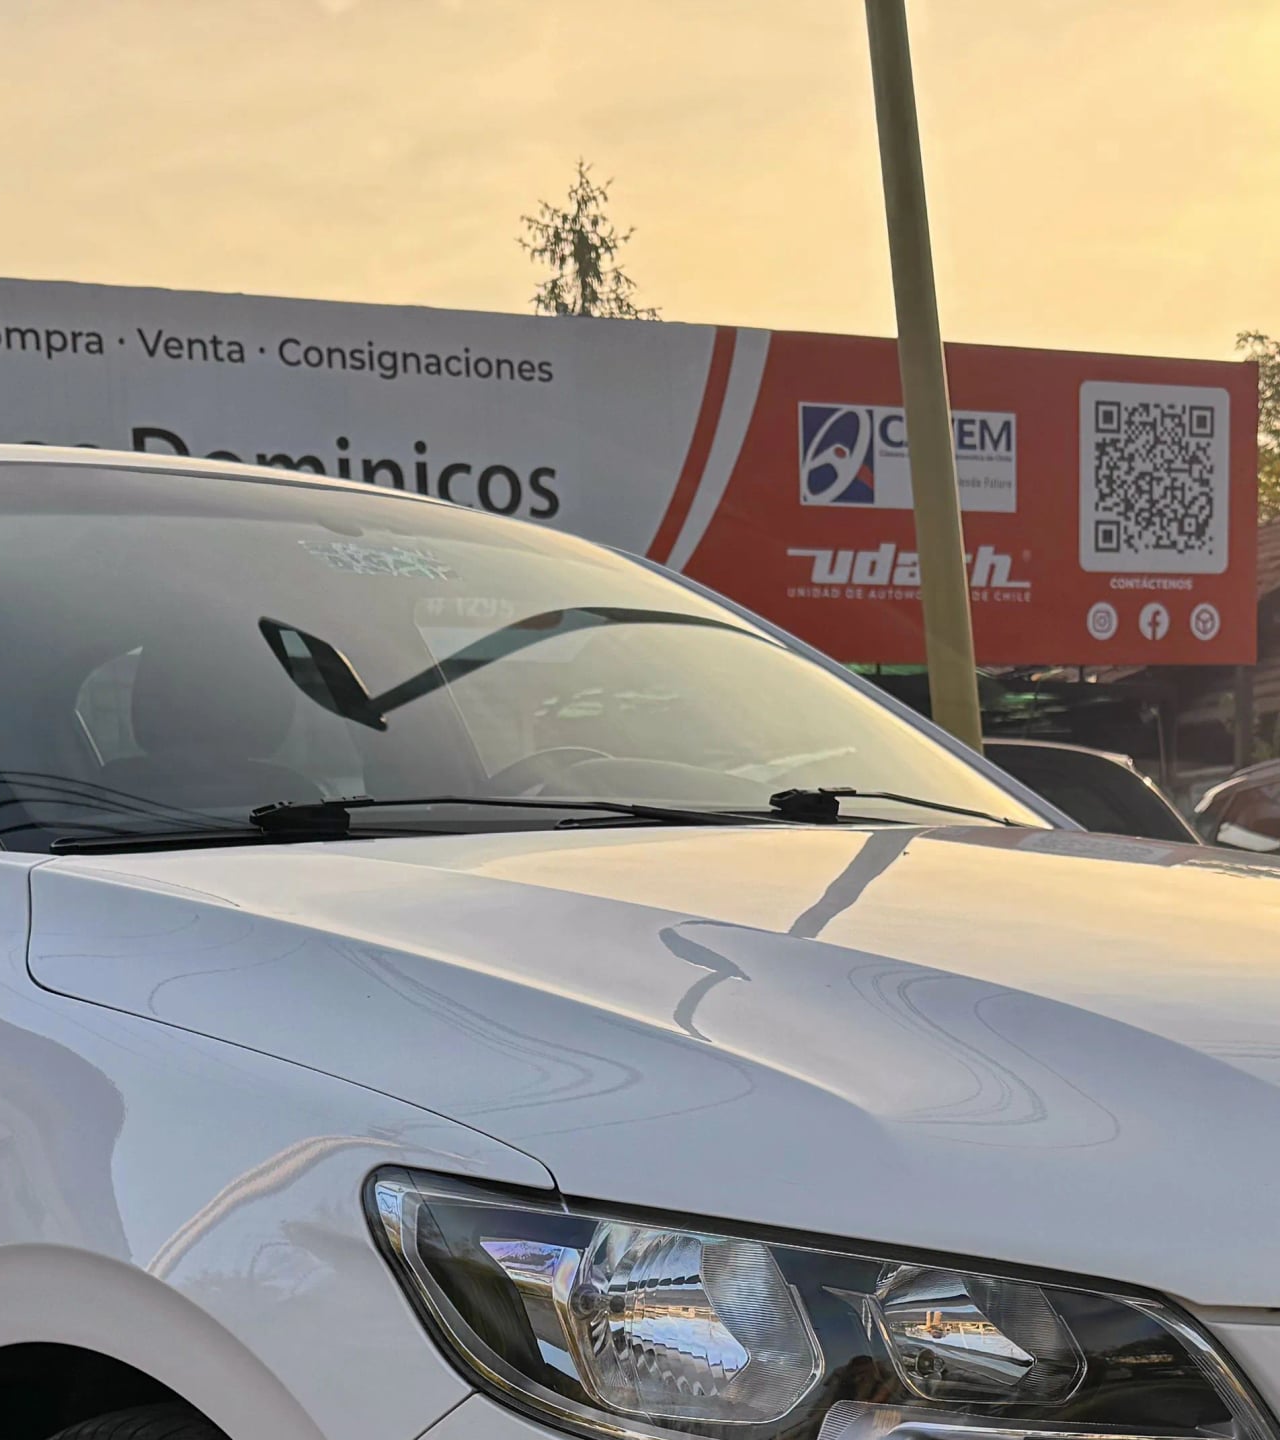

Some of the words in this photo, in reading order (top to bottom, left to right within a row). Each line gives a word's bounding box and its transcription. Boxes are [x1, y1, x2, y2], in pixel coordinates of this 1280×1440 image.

[136, 327, 246, 364] Venta
[278, 336, 554, 384] Consignaciones
[878, 413, 1013, 452] CEM
[787, 543, 1031, 588] udah
